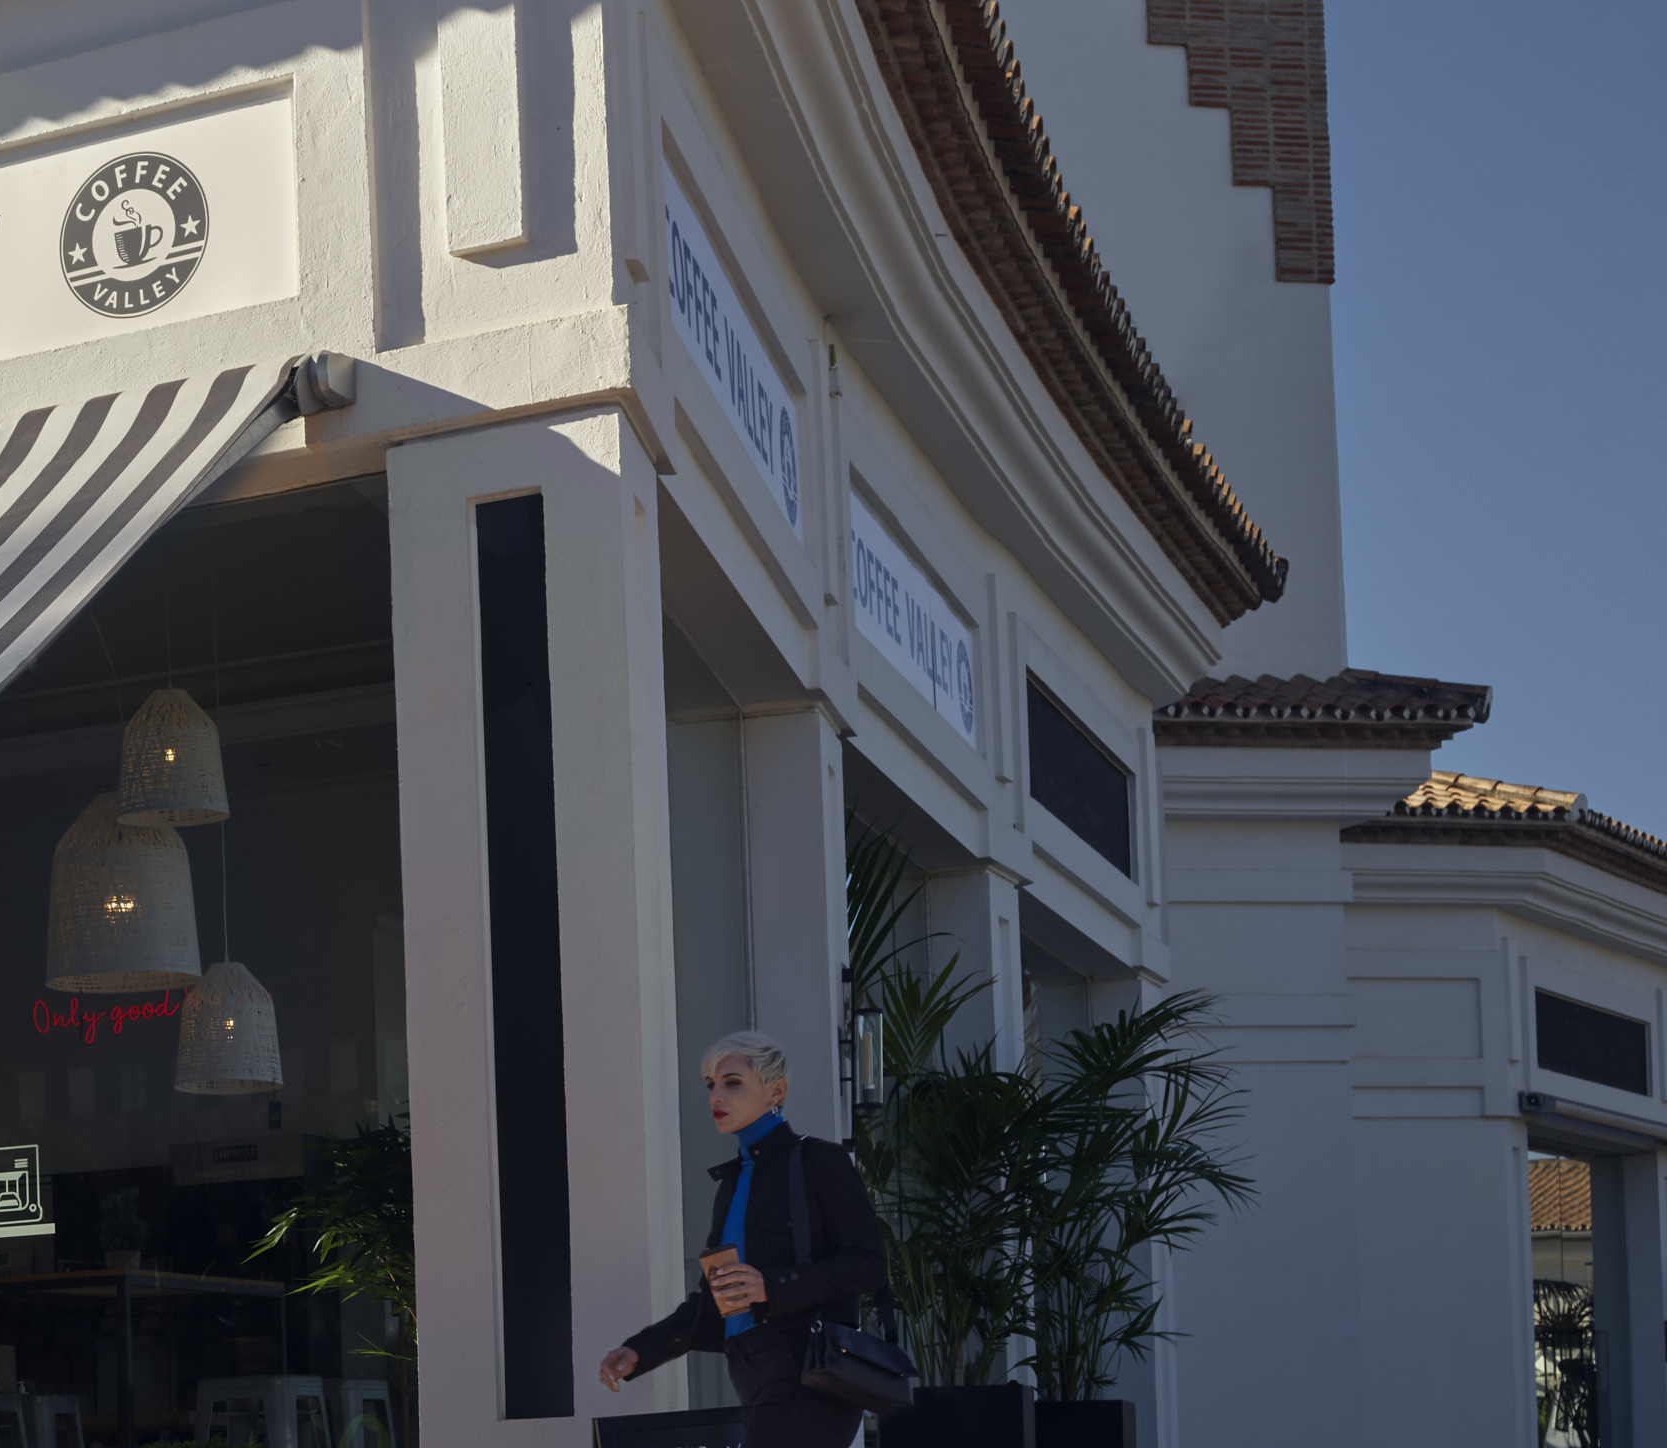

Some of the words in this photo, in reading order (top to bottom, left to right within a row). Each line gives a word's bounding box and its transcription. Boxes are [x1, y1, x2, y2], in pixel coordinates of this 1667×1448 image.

[76, 161, 188, 222] COFFEE
[93, 267, 180, 308] VALLEY
[724, 315, 774, 475] VALLEY
[905, 591, 954, 700] VALLEY
[33, 998, 106, 1044] Only
[110, 989, 181, 1034] good
